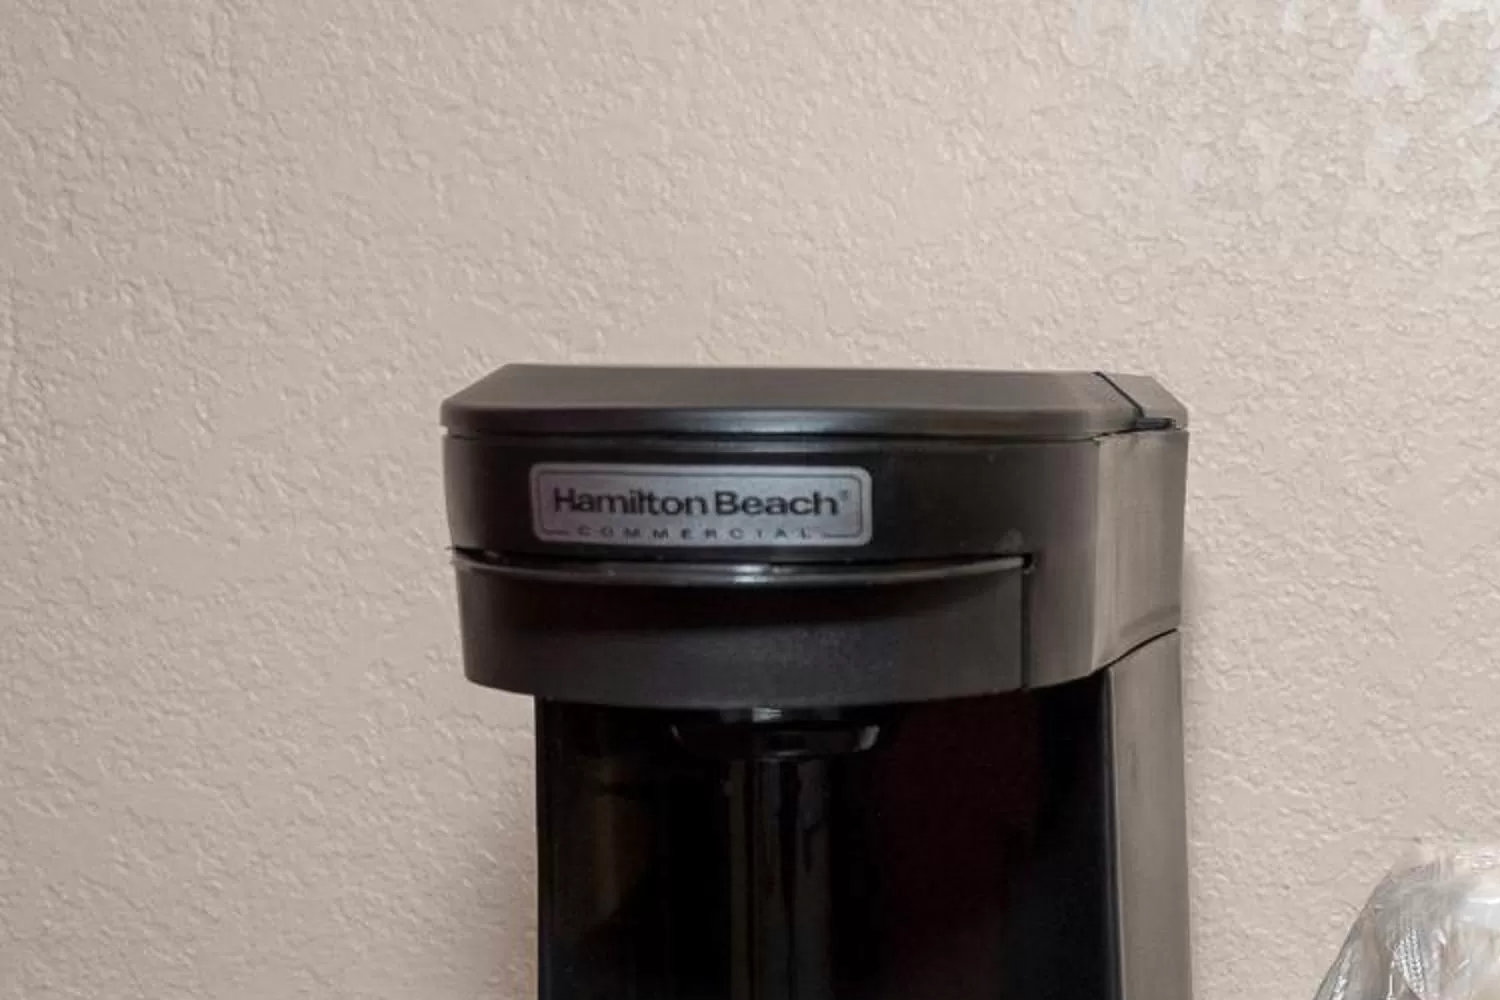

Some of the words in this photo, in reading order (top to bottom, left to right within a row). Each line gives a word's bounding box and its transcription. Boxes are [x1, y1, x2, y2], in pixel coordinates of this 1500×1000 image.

[553, 487, 708, 516] Hamilton
[713, 489, 840, 517] Beach
[577, 526, 813, 540] COMMERCIAL
